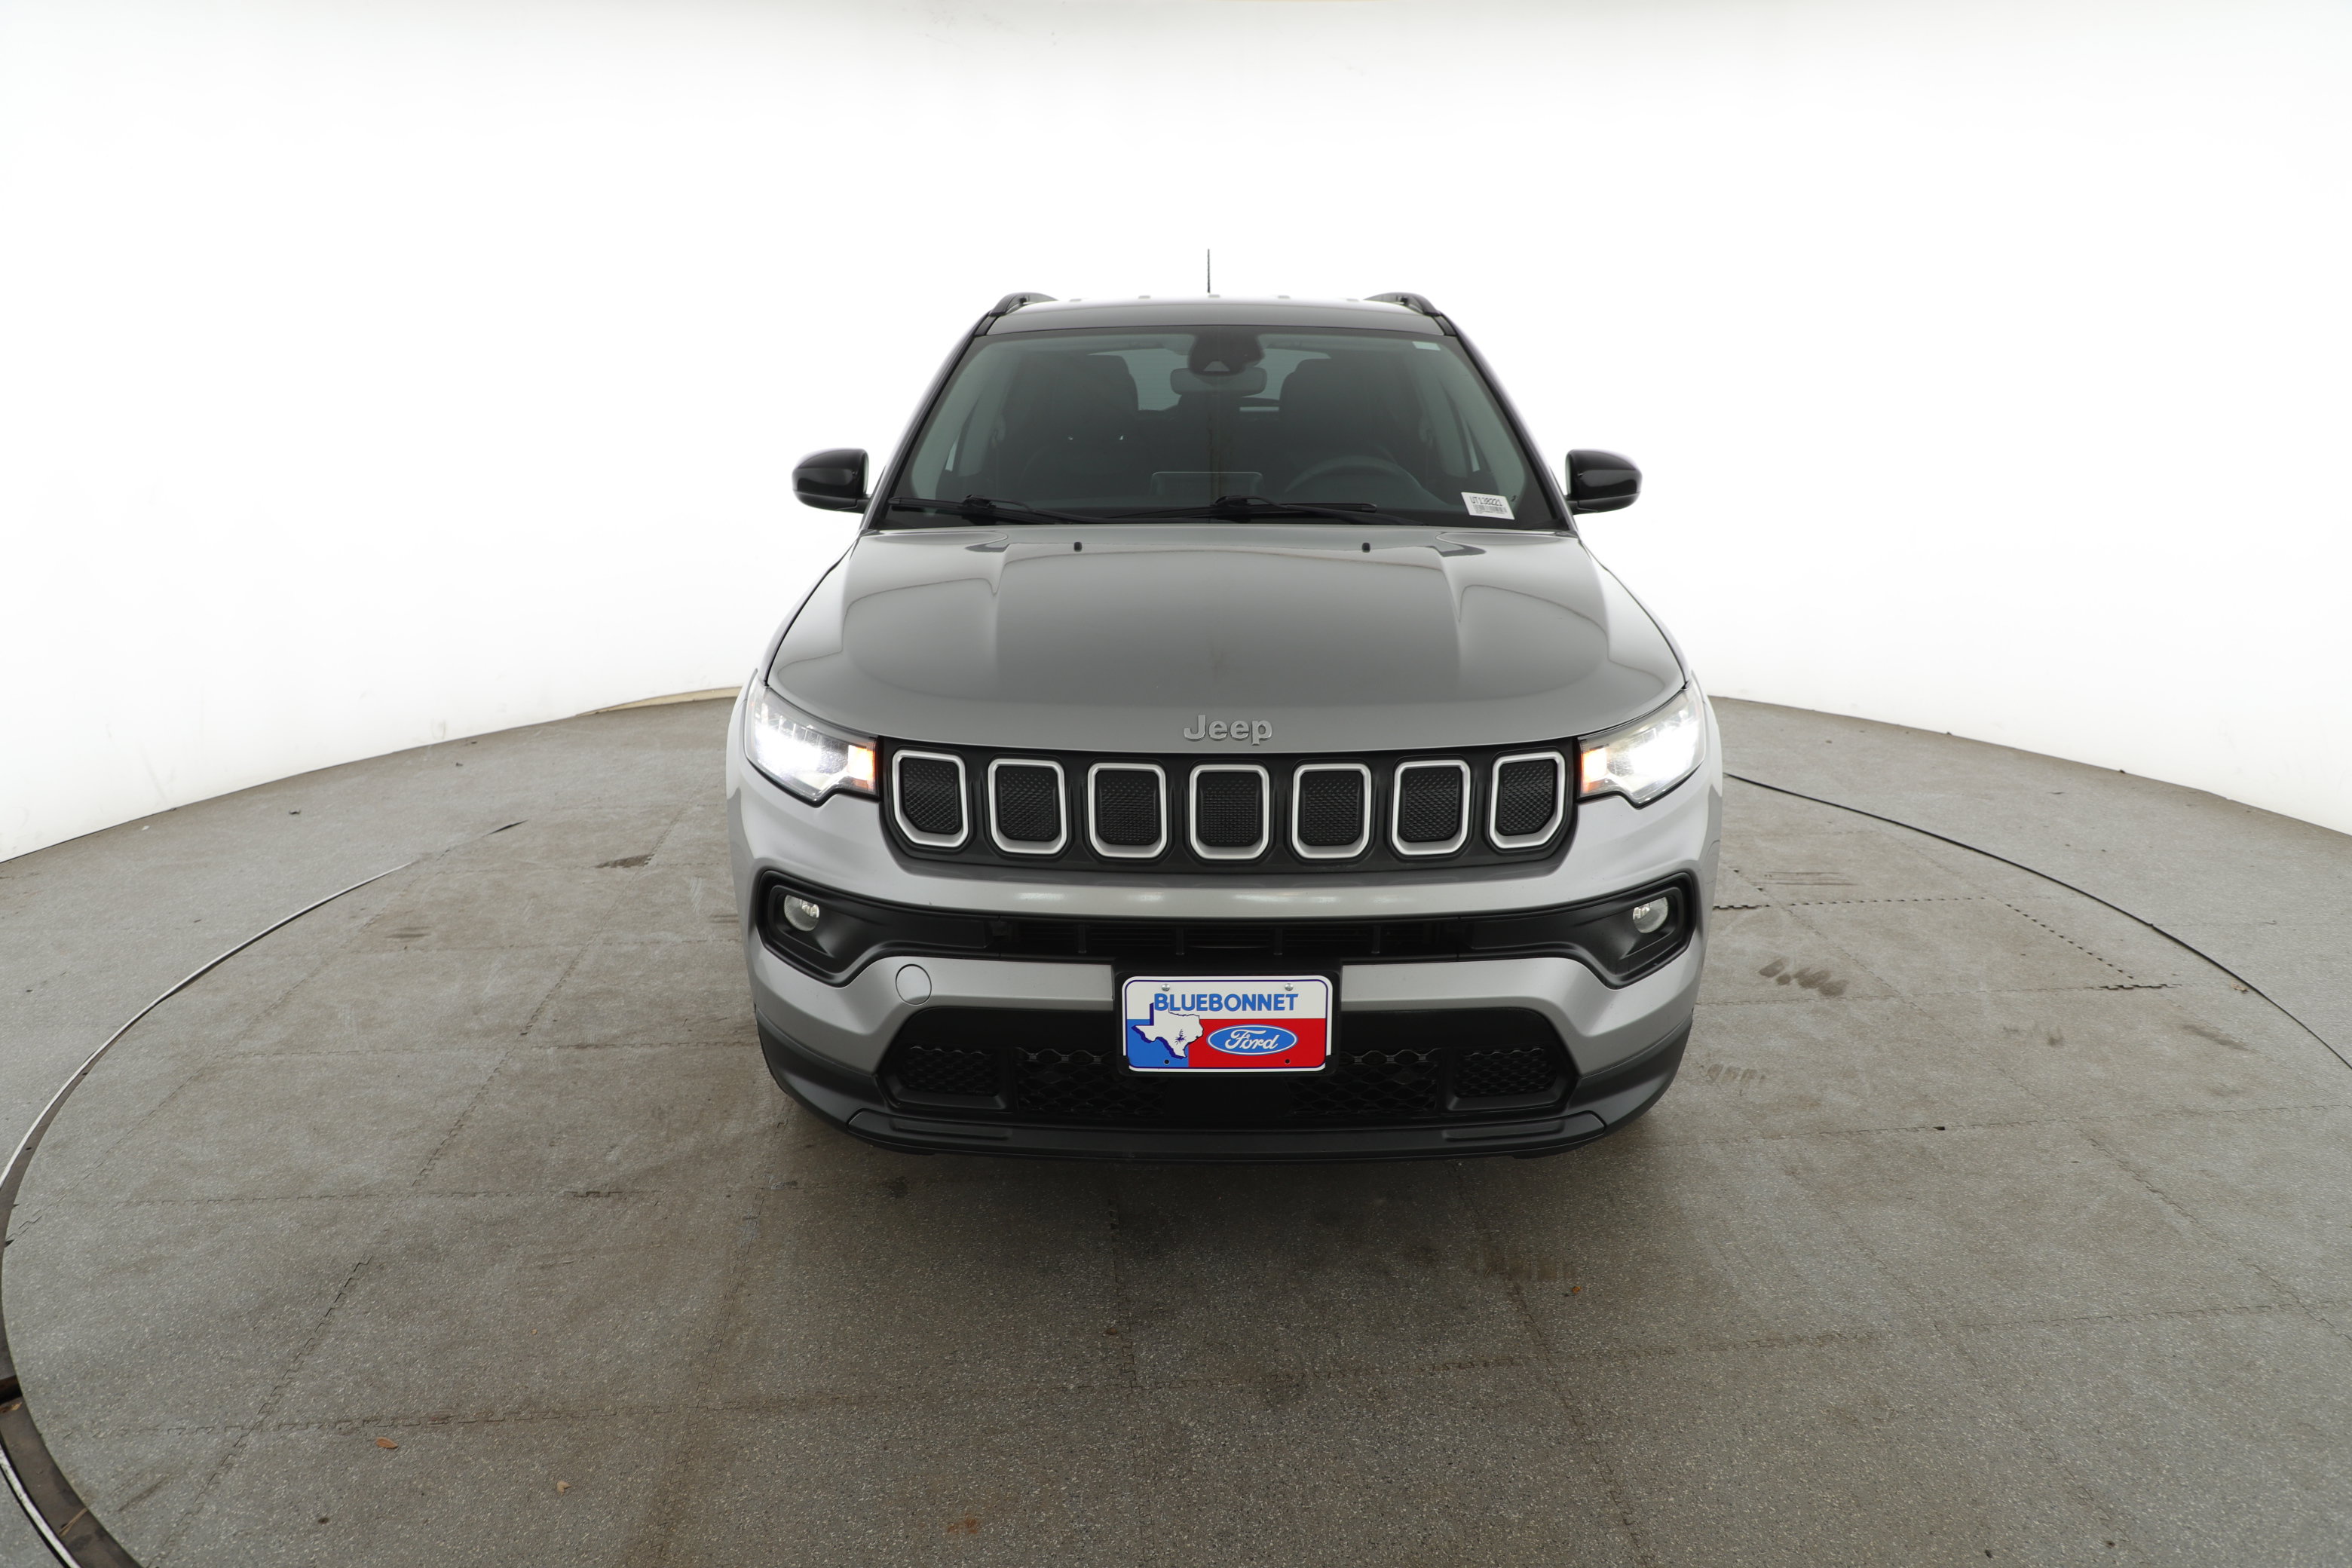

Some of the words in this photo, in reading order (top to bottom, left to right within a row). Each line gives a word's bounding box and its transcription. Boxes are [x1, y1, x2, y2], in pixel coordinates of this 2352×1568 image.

[1184, 715, 1272, 746] Jeep
[1154, 993, 1298, 1012] BLUEBONNET
[1224, 1029, 1280, 1049] Ford
